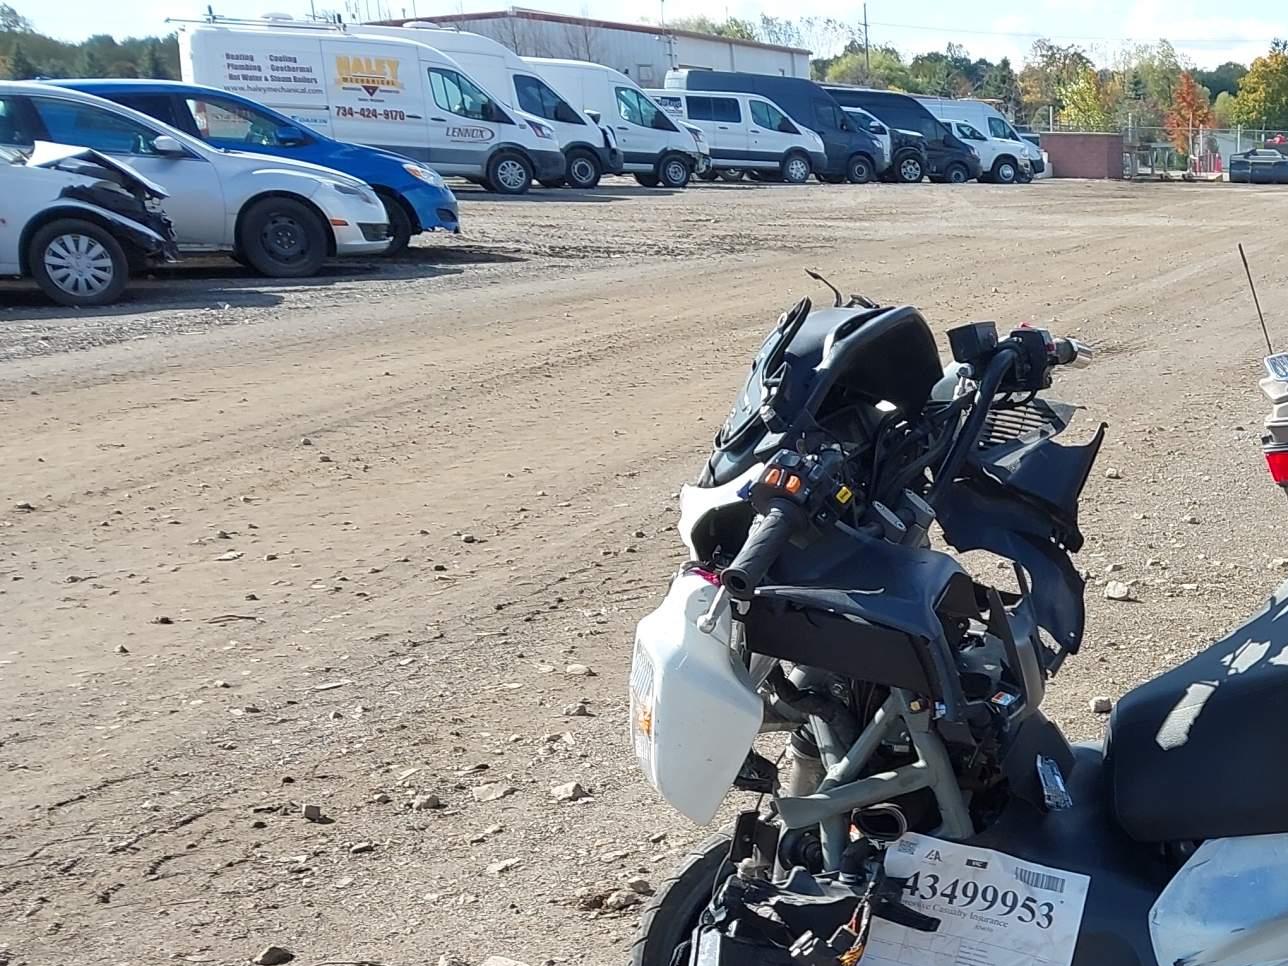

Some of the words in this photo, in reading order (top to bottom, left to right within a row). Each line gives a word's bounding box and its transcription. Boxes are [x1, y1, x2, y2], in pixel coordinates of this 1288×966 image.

[225, 52, 254, 62] Heating
[269, 54, 297, 64] Cooling
[227, 62, 262, 73] Plumbing
[270, 64, 312, 73] Geothermal
[336, 55, 399, 80] HALEY
[228, 73, 241, 81] Hot
[241, 74, 262, 82] Water
[342, 76, 396, 86] MECHANICAL
[224, 84, 324, 95] www.haleymechanical.com
[335, 105, 405, 120] 734-424-9170
[446, 127, 485, 139] LENNOX
[901, 870, 1055, 930] 43499953
[932, 902, 968, 919] Casualty
[969, 911, 1009, 928] Insurance
